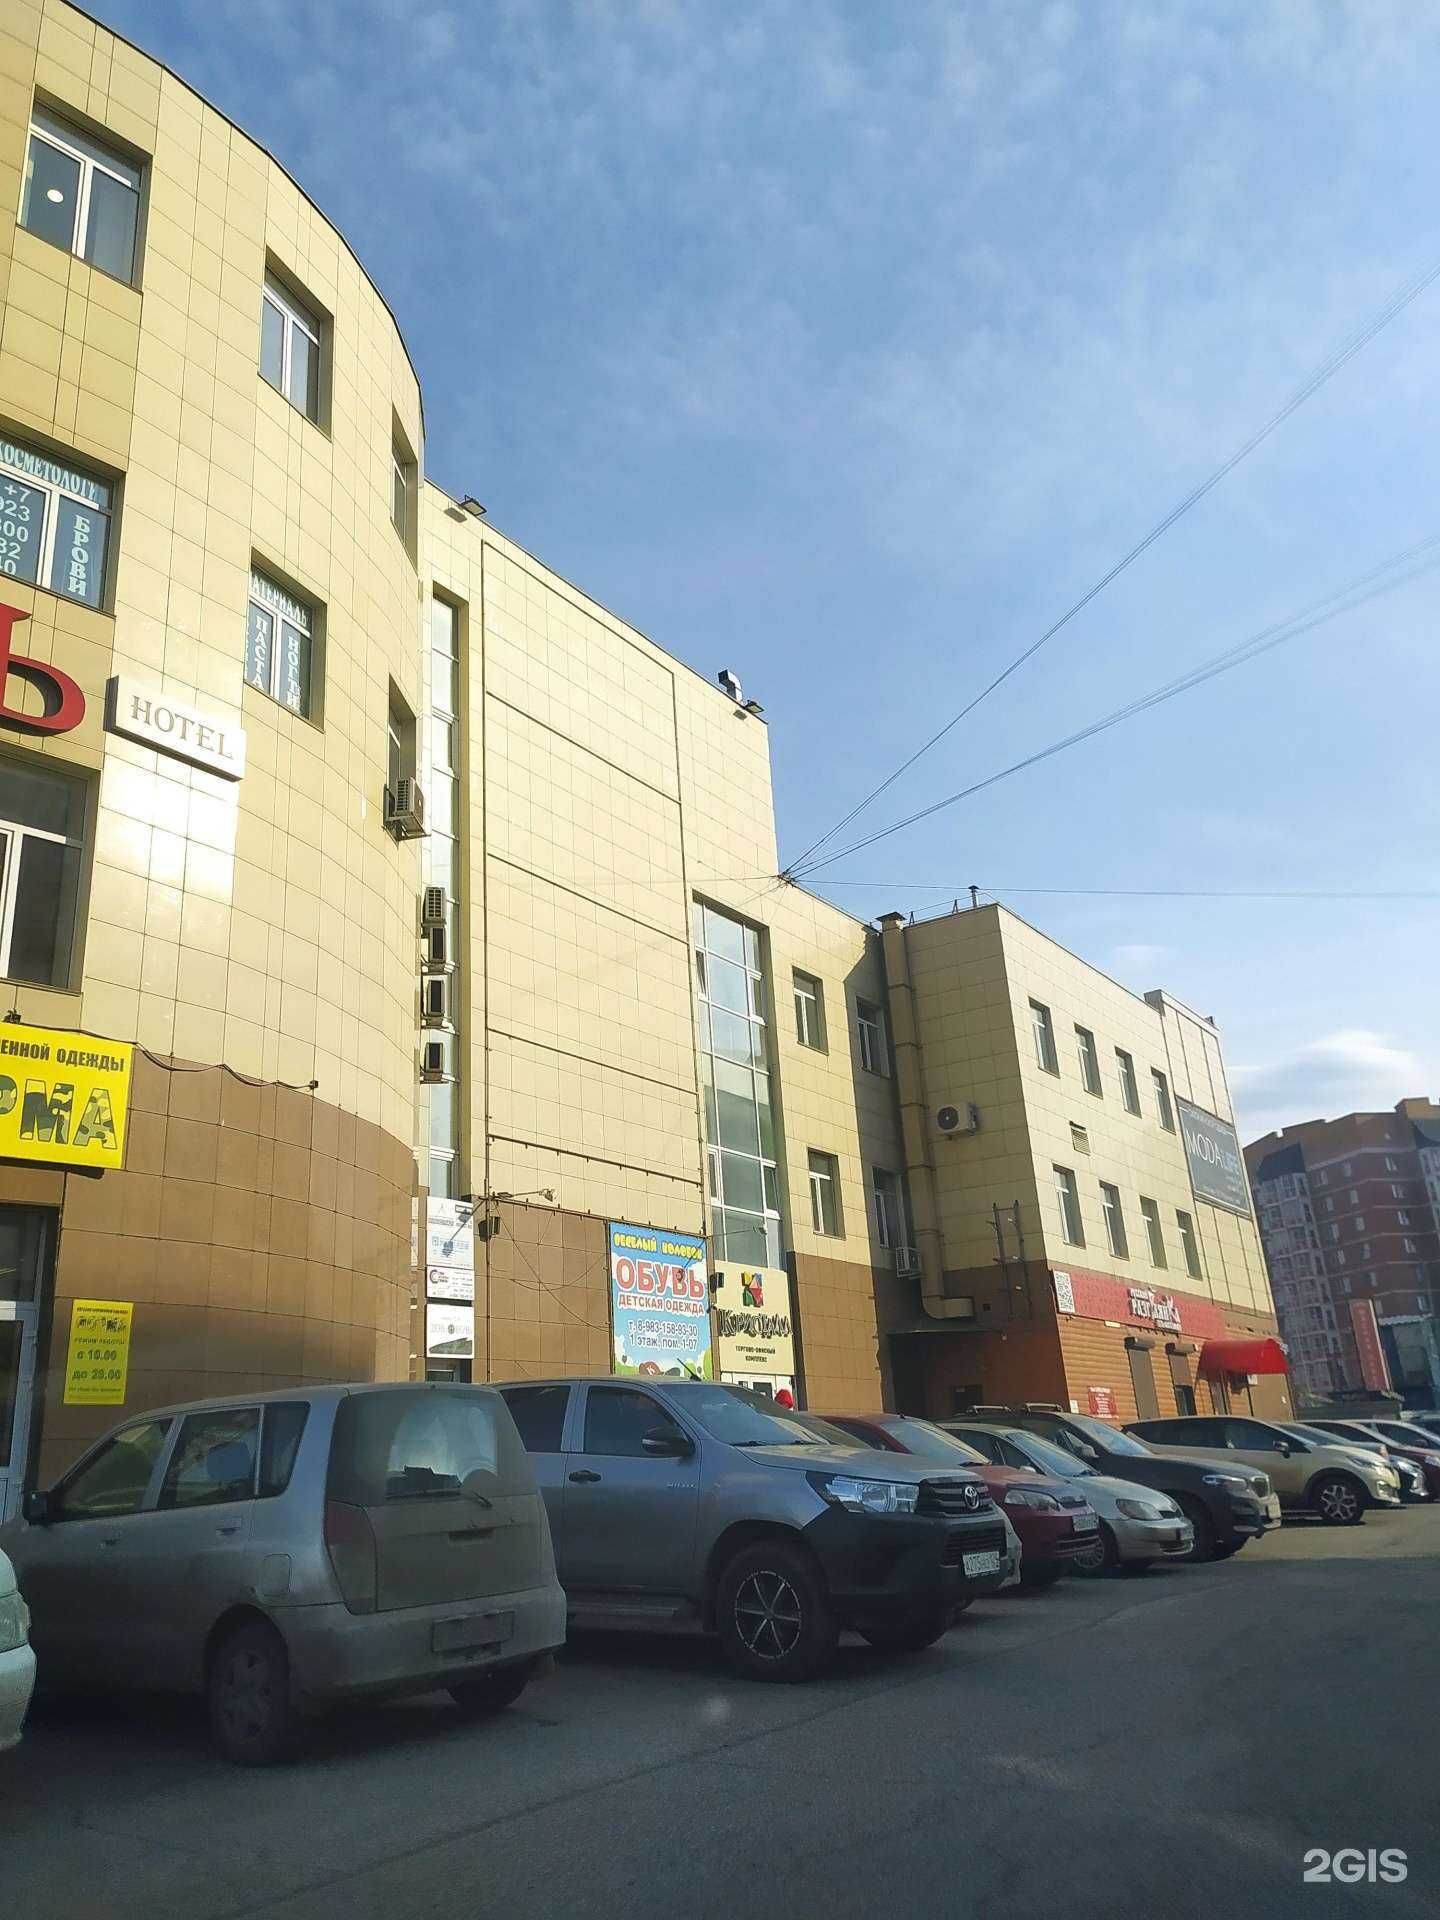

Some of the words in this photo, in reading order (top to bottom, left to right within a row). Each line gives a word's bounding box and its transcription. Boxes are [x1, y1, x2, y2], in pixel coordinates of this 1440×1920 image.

[4, 484, 31, 503] +7
[0, 521, 29, 543] 00
[67, 514, 91, 597] БРОВИ
[252, 614, 268, 690] ПАСТА
[129, 693, 234, 761] HOTEL
[56, 1048, 124, 1073] ОДЕЖДЫ
[615, 1257, 705, 1299] ОБУВЬ
[618, 1294, 663, 1310] ДЕТСКАЯ
[665, 1299, 705, 1316] ОДЕЖДА
